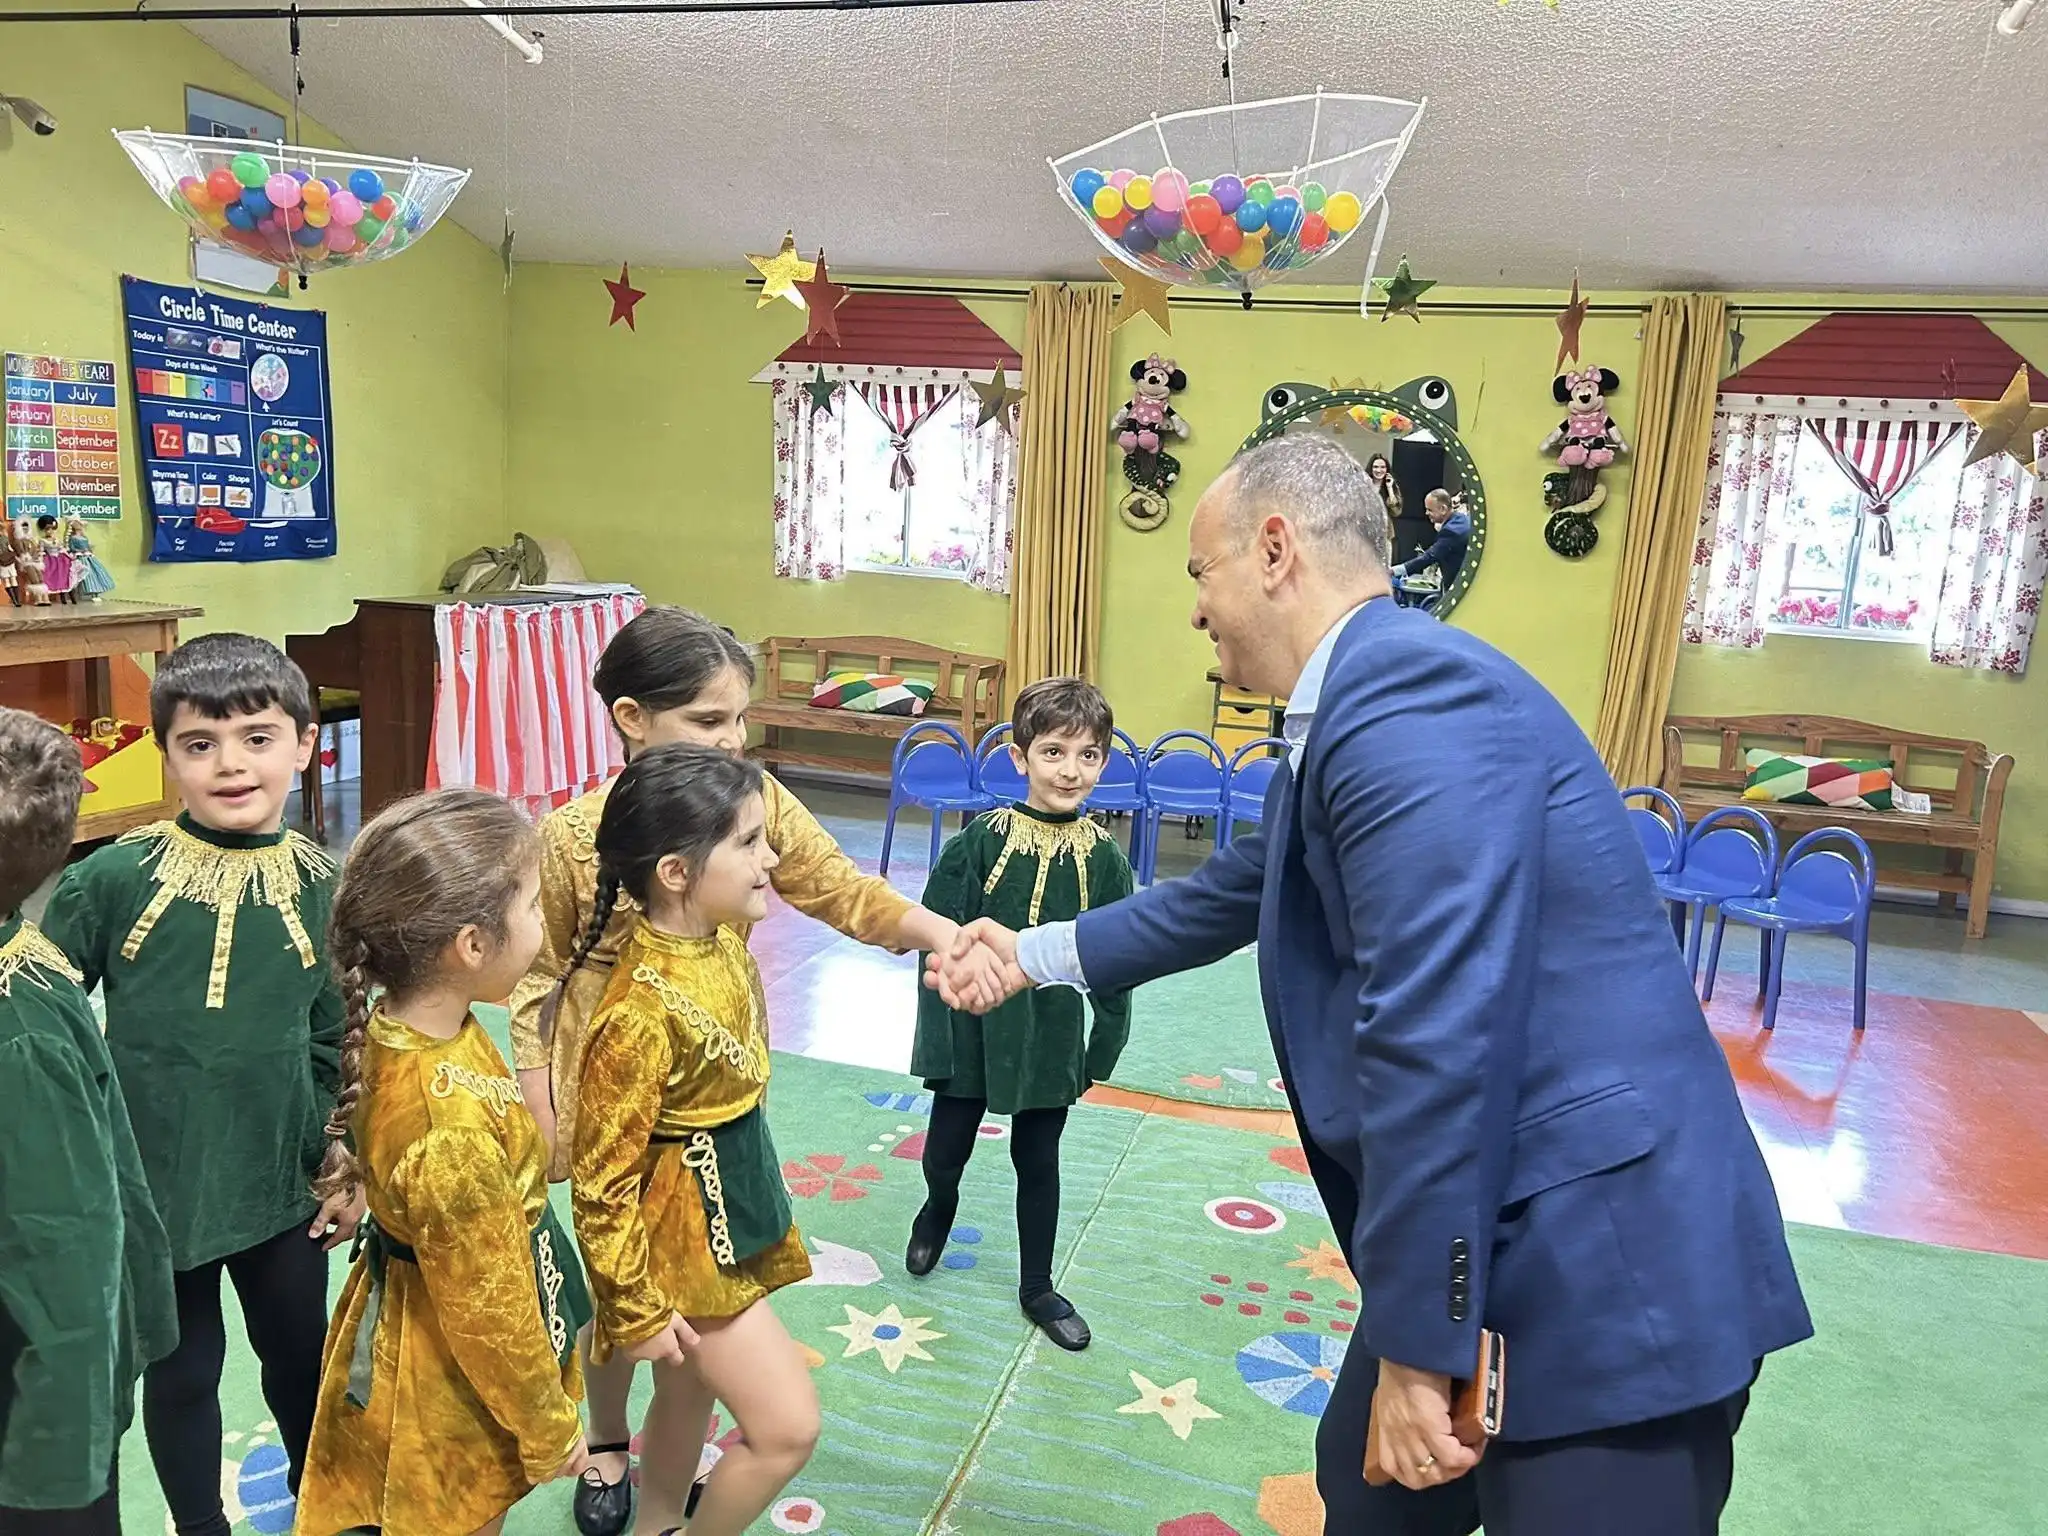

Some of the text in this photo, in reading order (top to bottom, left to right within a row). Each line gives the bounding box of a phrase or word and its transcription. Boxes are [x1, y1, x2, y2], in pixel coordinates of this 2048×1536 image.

[160, 295, 297, 340] Circle Time Center
[133, 330, 164, 342] Today is
[57, 361, 76, 378] THE
[79, 363, 109, 381] YEAR!
[165, 359, 181, 370] Days
[182, 360, 189, 369] of
[190, 361, 200, 370] the
[7, 379, 50, 400] January
[68, 386, 98, 404] July
[7, 405, 51, 424] February
[60, 407, 110, 427] August
[8, 427, 49, 444] March
[57, 430, 116, 449] September
[158, 428, 179, 449] Zz
[15, 452, 45, 469] April
[59, 454, 115, 471] October
[60, 477, 117, 493] November
[228, 474, 250, 484] Shape
[16, 499, 48, 514] June
[62, 497, 118, 515] December
